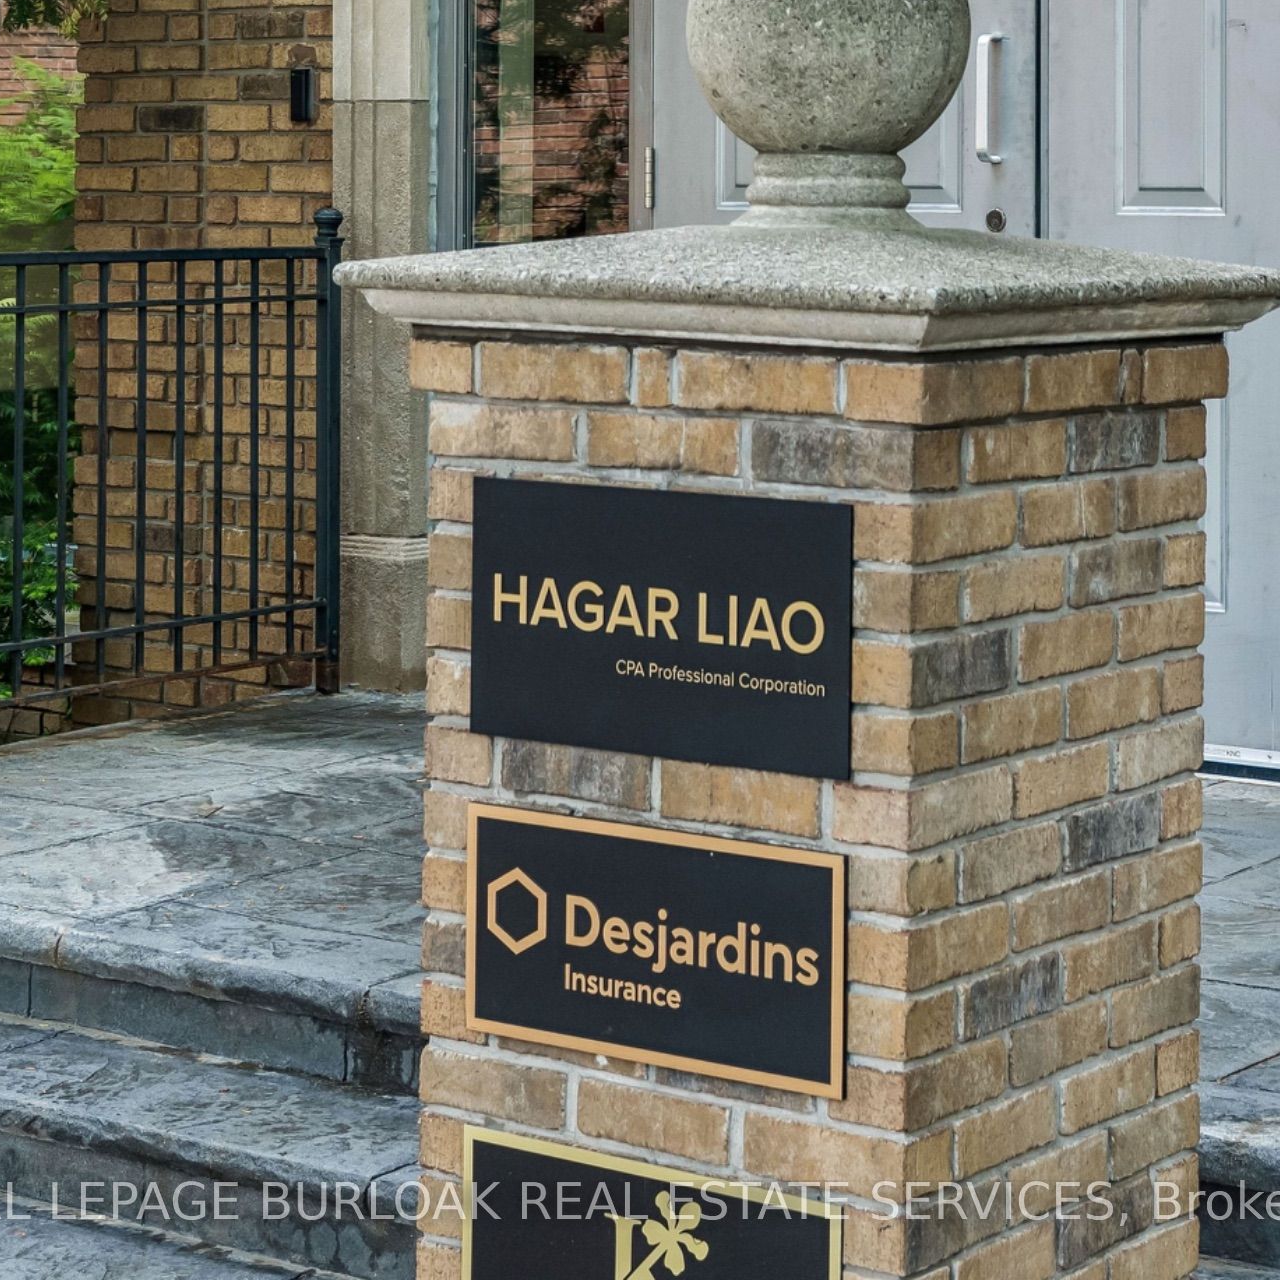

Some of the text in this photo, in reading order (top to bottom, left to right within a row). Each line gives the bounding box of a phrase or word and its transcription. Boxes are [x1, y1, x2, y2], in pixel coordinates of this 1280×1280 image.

[493, 572, 826, 655] HAGAR LIAO
[615, 659, 825, 697] CPA Professional Corporation
[565, 894, 820, 987] Desjardins
[563, 963, 682, 1009] Insurance
